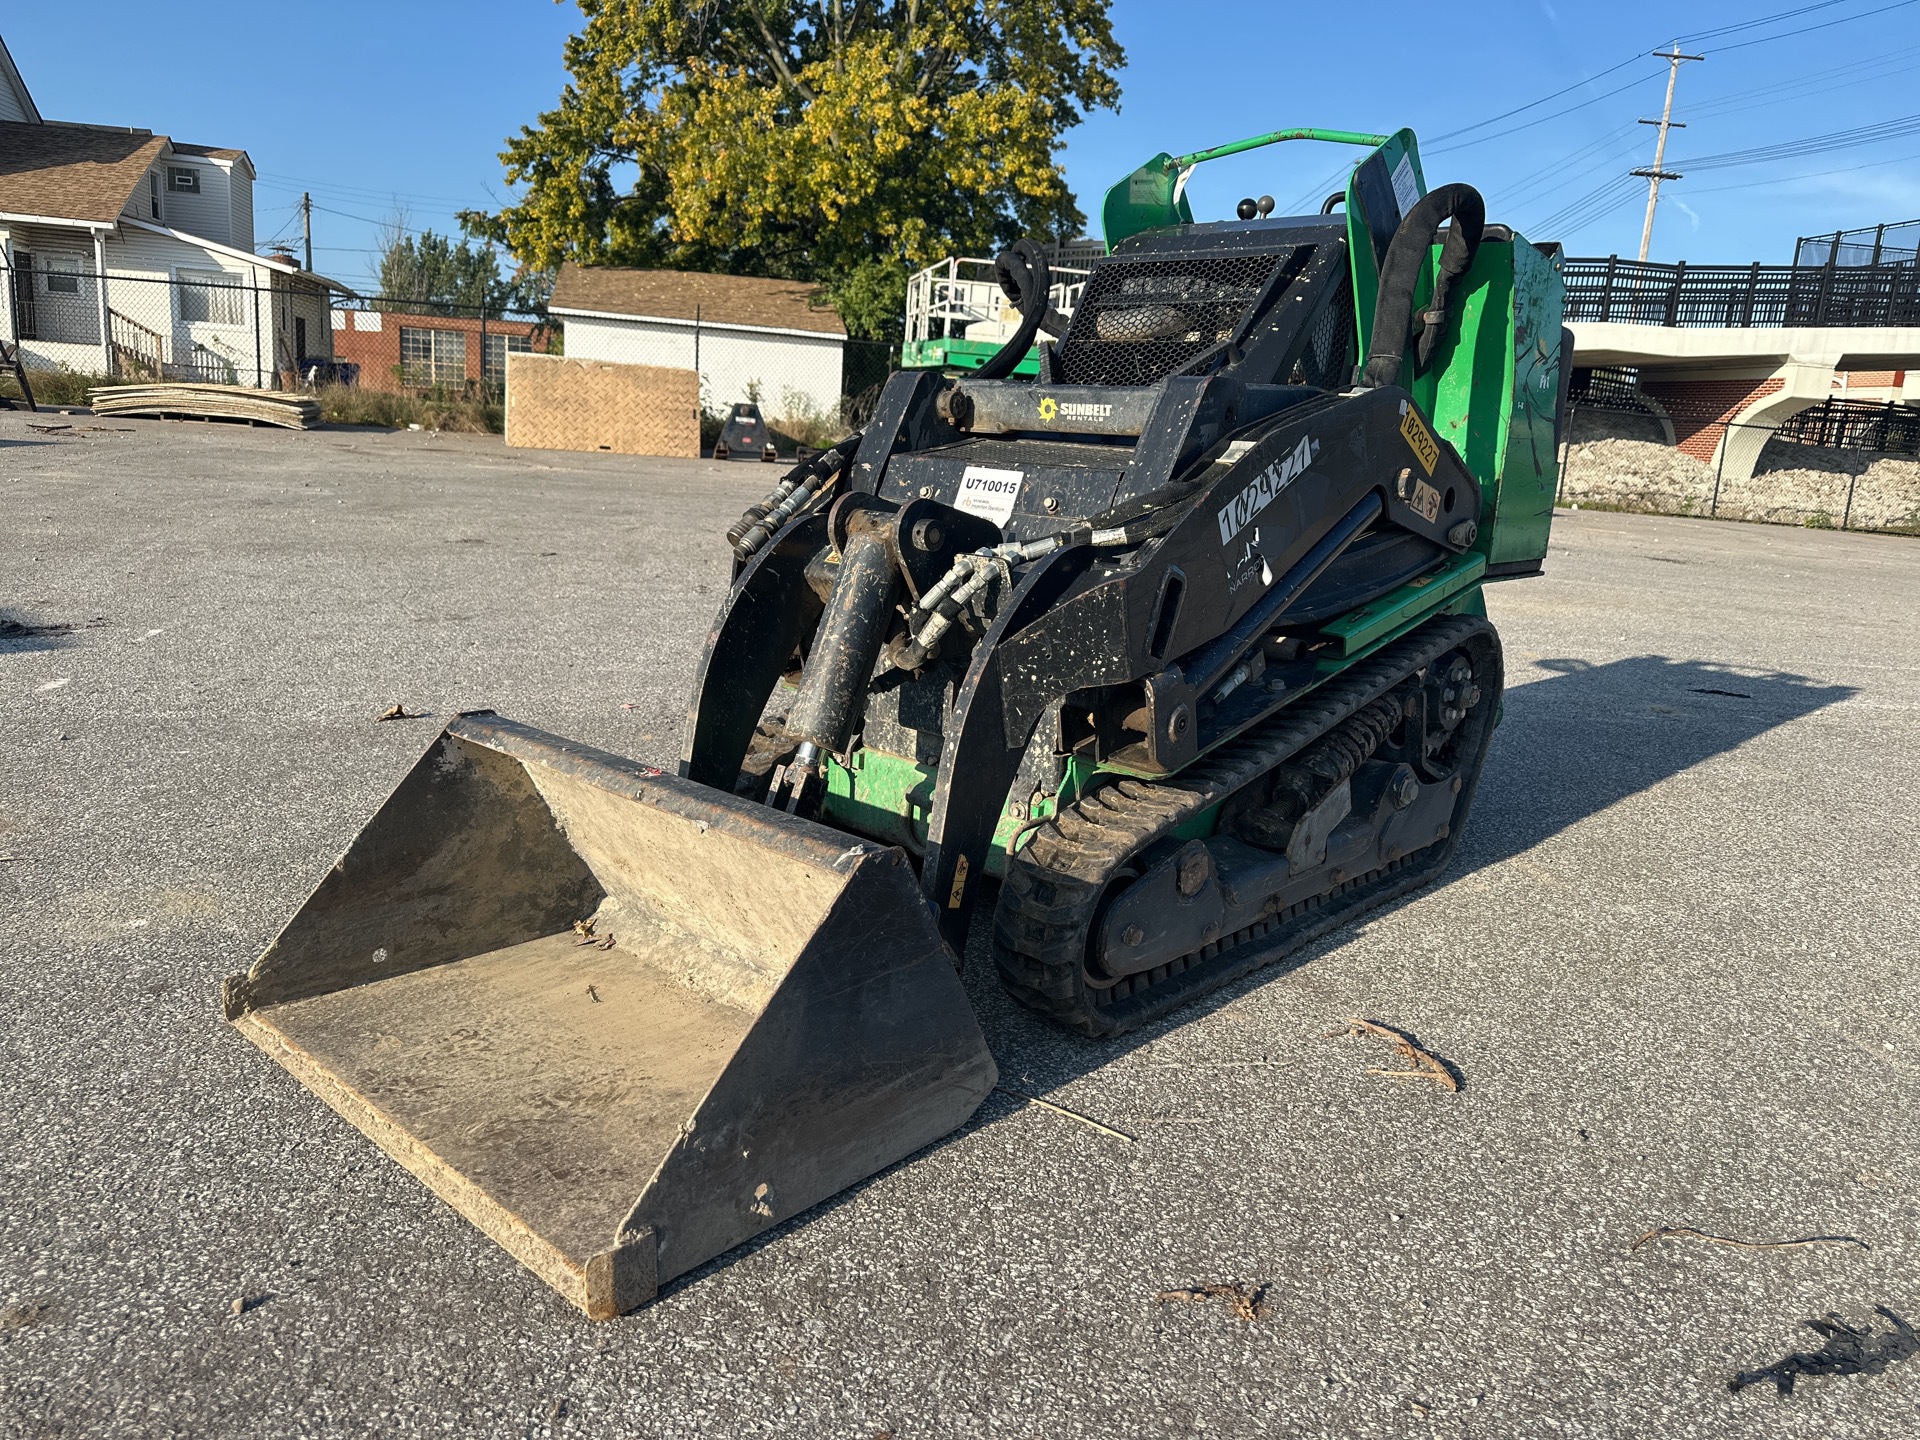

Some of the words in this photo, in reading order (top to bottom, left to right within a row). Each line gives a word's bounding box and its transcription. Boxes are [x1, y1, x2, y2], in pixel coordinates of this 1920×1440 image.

[1060, 403, 1112, 417] SUNBELT
[1403, 410, 1438, 468] 1029227
[966, 478, 1017, 494] U710015
